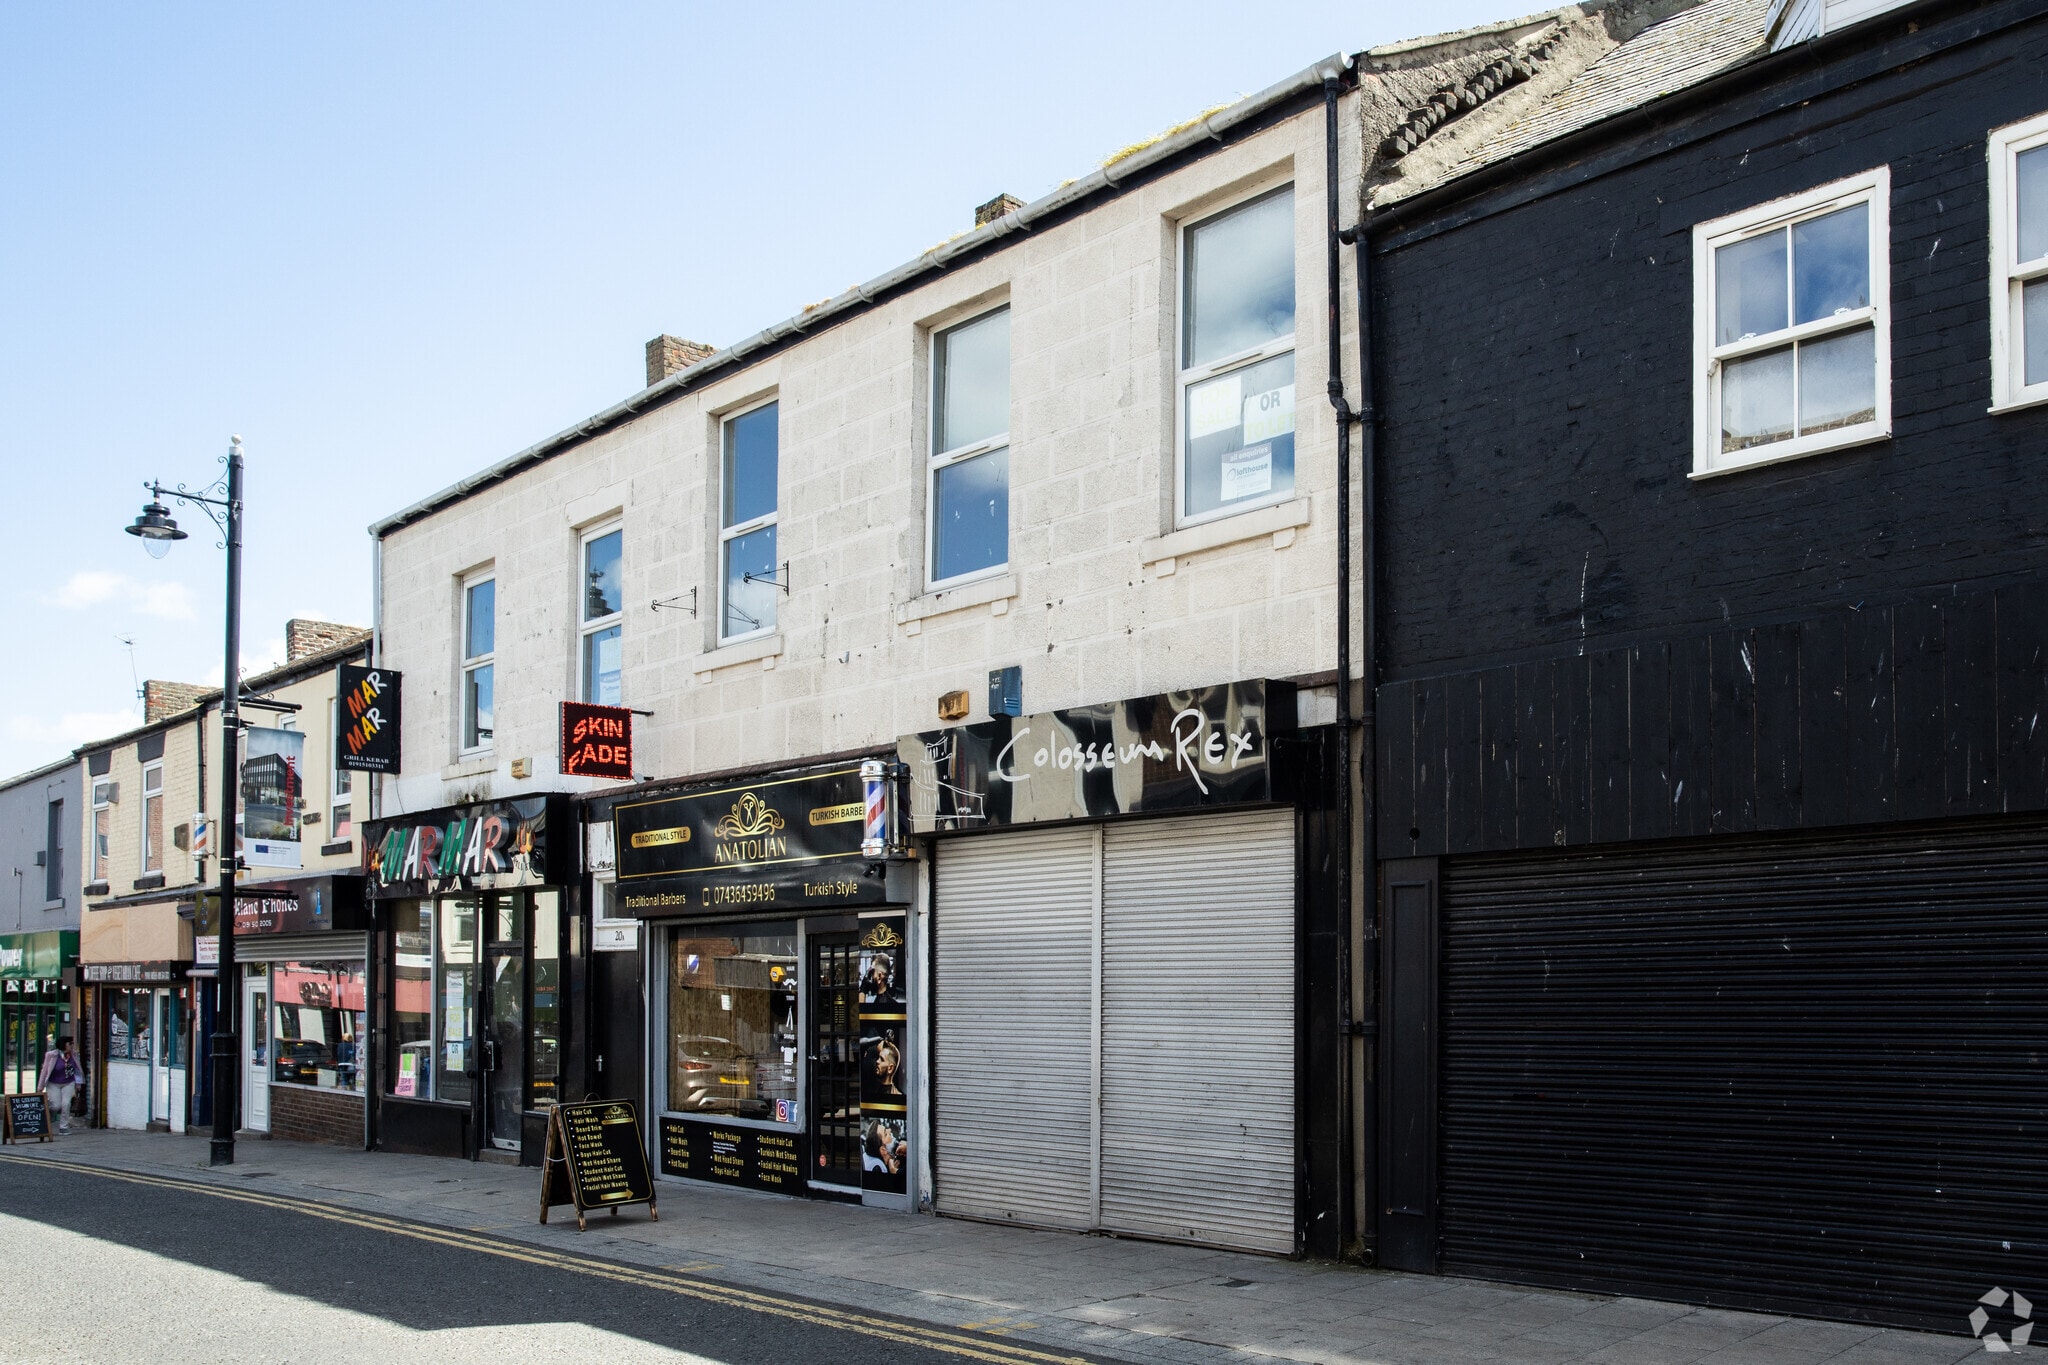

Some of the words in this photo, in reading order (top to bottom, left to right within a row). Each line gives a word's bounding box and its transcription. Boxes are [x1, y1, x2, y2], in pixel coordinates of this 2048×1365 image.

[1260, 391, 1280, 411] OR
[1246, 422, 1264, 440] TO
[1268, 412, 1295, 434] LET
[1239, 447, 1268, 459] enquiries
[347, 672, 387, 718] MAR
[347, 708, 387, 754] MAR
[573, 716, 622, 743] SKIN
[996, 728, 1163, 782] Colosseum
[284, 755, 295, 826] Investment
[812, 810, 839, 821] TURKISH
[636, 832, 669, 844] TRADITIONAL
[671, 830, 686, 840] STYLE
[714, 837, 787, 863] ANATOLIAN
[714, 883, 775, 904] 07436459496
[804, 882, 834, 896] Turkish
[837, 880, 858, 897] Style
[262, 898, 298, 914] Phones
[625, 893, 659, 908] Traditional
[661, 892, 686, 905] Barbers
[0, 945, 22, 966] ower
[670, 1136, 678, 1144] Hair
[713, 1131, 724, 1140] Works
[725, 1132, 741, 1144] Package
[760, 1135, 775, 1144] Student
[776, 1137, 785, 1146] Hair
[670, 1148, 681, 1156] Beard
[722, 1155, 732, 1164] Head
[760, 1148, 775, 1157] Turkish
[776, 1150, 784, 1159] Wet
[678, 1160, 688, 1169] Towel
[714, 1166, 724, 1176] Boys
[724, 1168, 732, 1176] Hair
[761, 1160, 773, 1169] Facial
[773, 1162, 782, 1170] Hair
[782, 1163, 798, 1175] Waxing
[761, 1173, 770, 1182] Face
[771, 1174, 781, 1183] Mask
